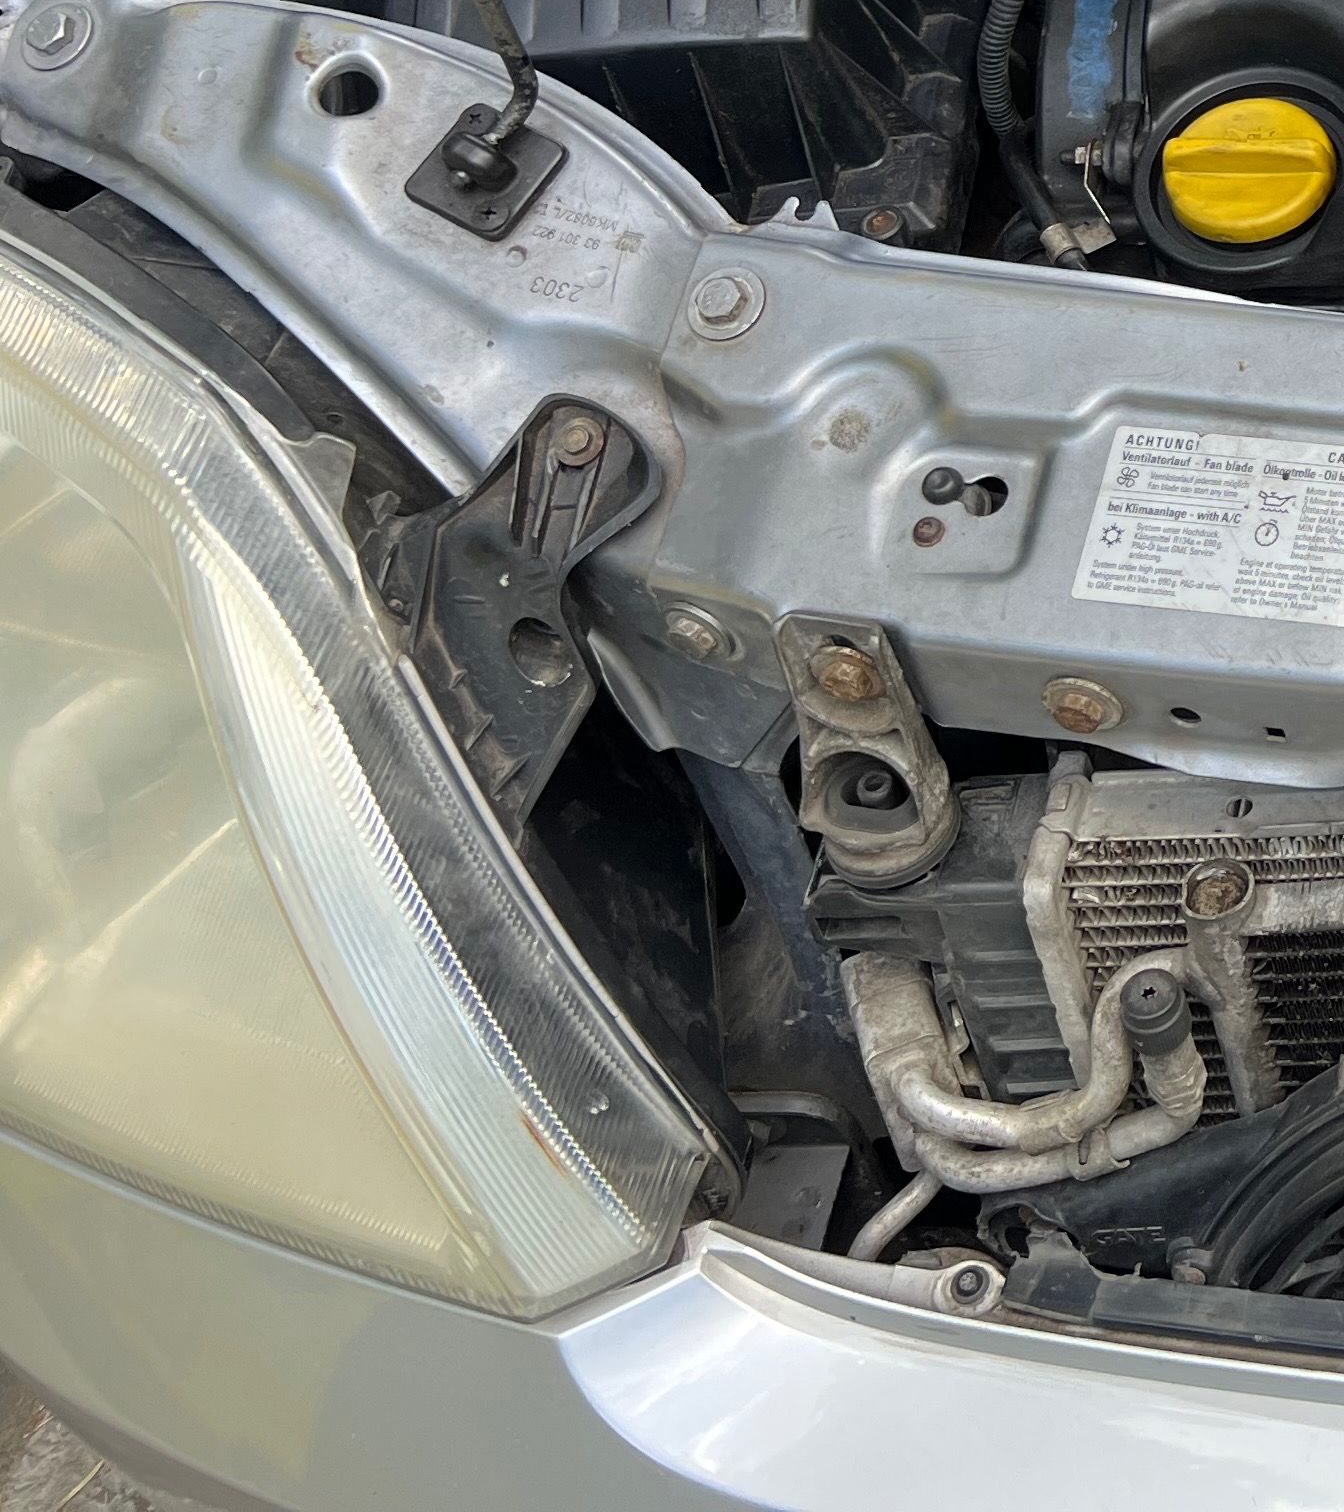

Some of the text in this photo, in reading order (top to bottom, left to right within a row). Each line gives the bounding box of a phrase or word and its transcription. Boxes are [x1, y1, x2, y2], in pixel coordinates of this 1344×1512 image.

[531, 225, 601, 251] 93 301 922
[529, 275, 584, 303] 2303
[1126, 434, 1201, 452] ACHTUNG!
[1122, 451, 1254, 473] Ventilatorlauf Fan blade
[1325, 470, 1337, 481] Oil
[1107, 501, 1242, 524] bei Klimaanlage with A/C
[1318, 516, 1336, 525] MAX
[1239, 558, 1265, 569] Engine
[1292, 573, 1314, 582] check
[1258, 579, 1277, 588] MAX
[1242, 587, 1267, 597] engine
